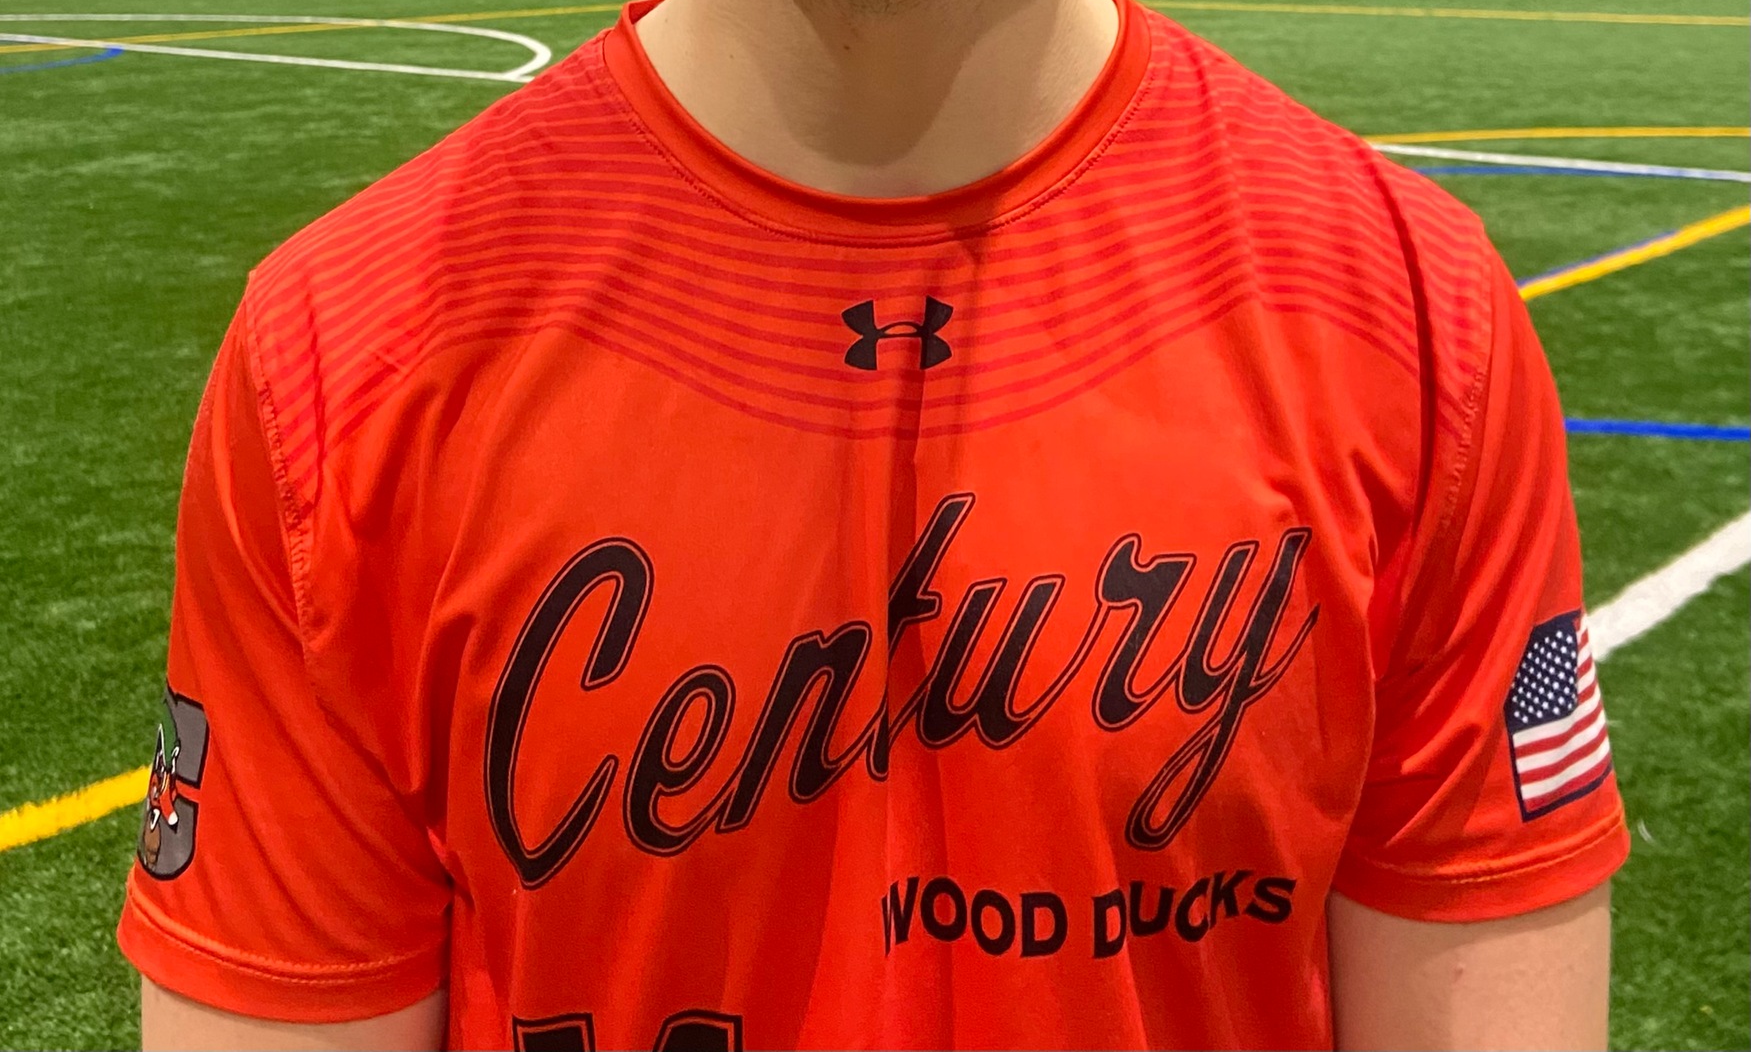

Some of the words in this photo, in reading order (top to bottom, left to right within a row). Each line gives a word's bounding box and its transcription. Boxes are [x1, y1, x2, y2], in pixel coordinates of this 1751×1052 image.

[486, 492, 1321, 890] Century
[881, 875, 1068, 959] WOOD
[1093, 869, 1297, 959] DUCKS
